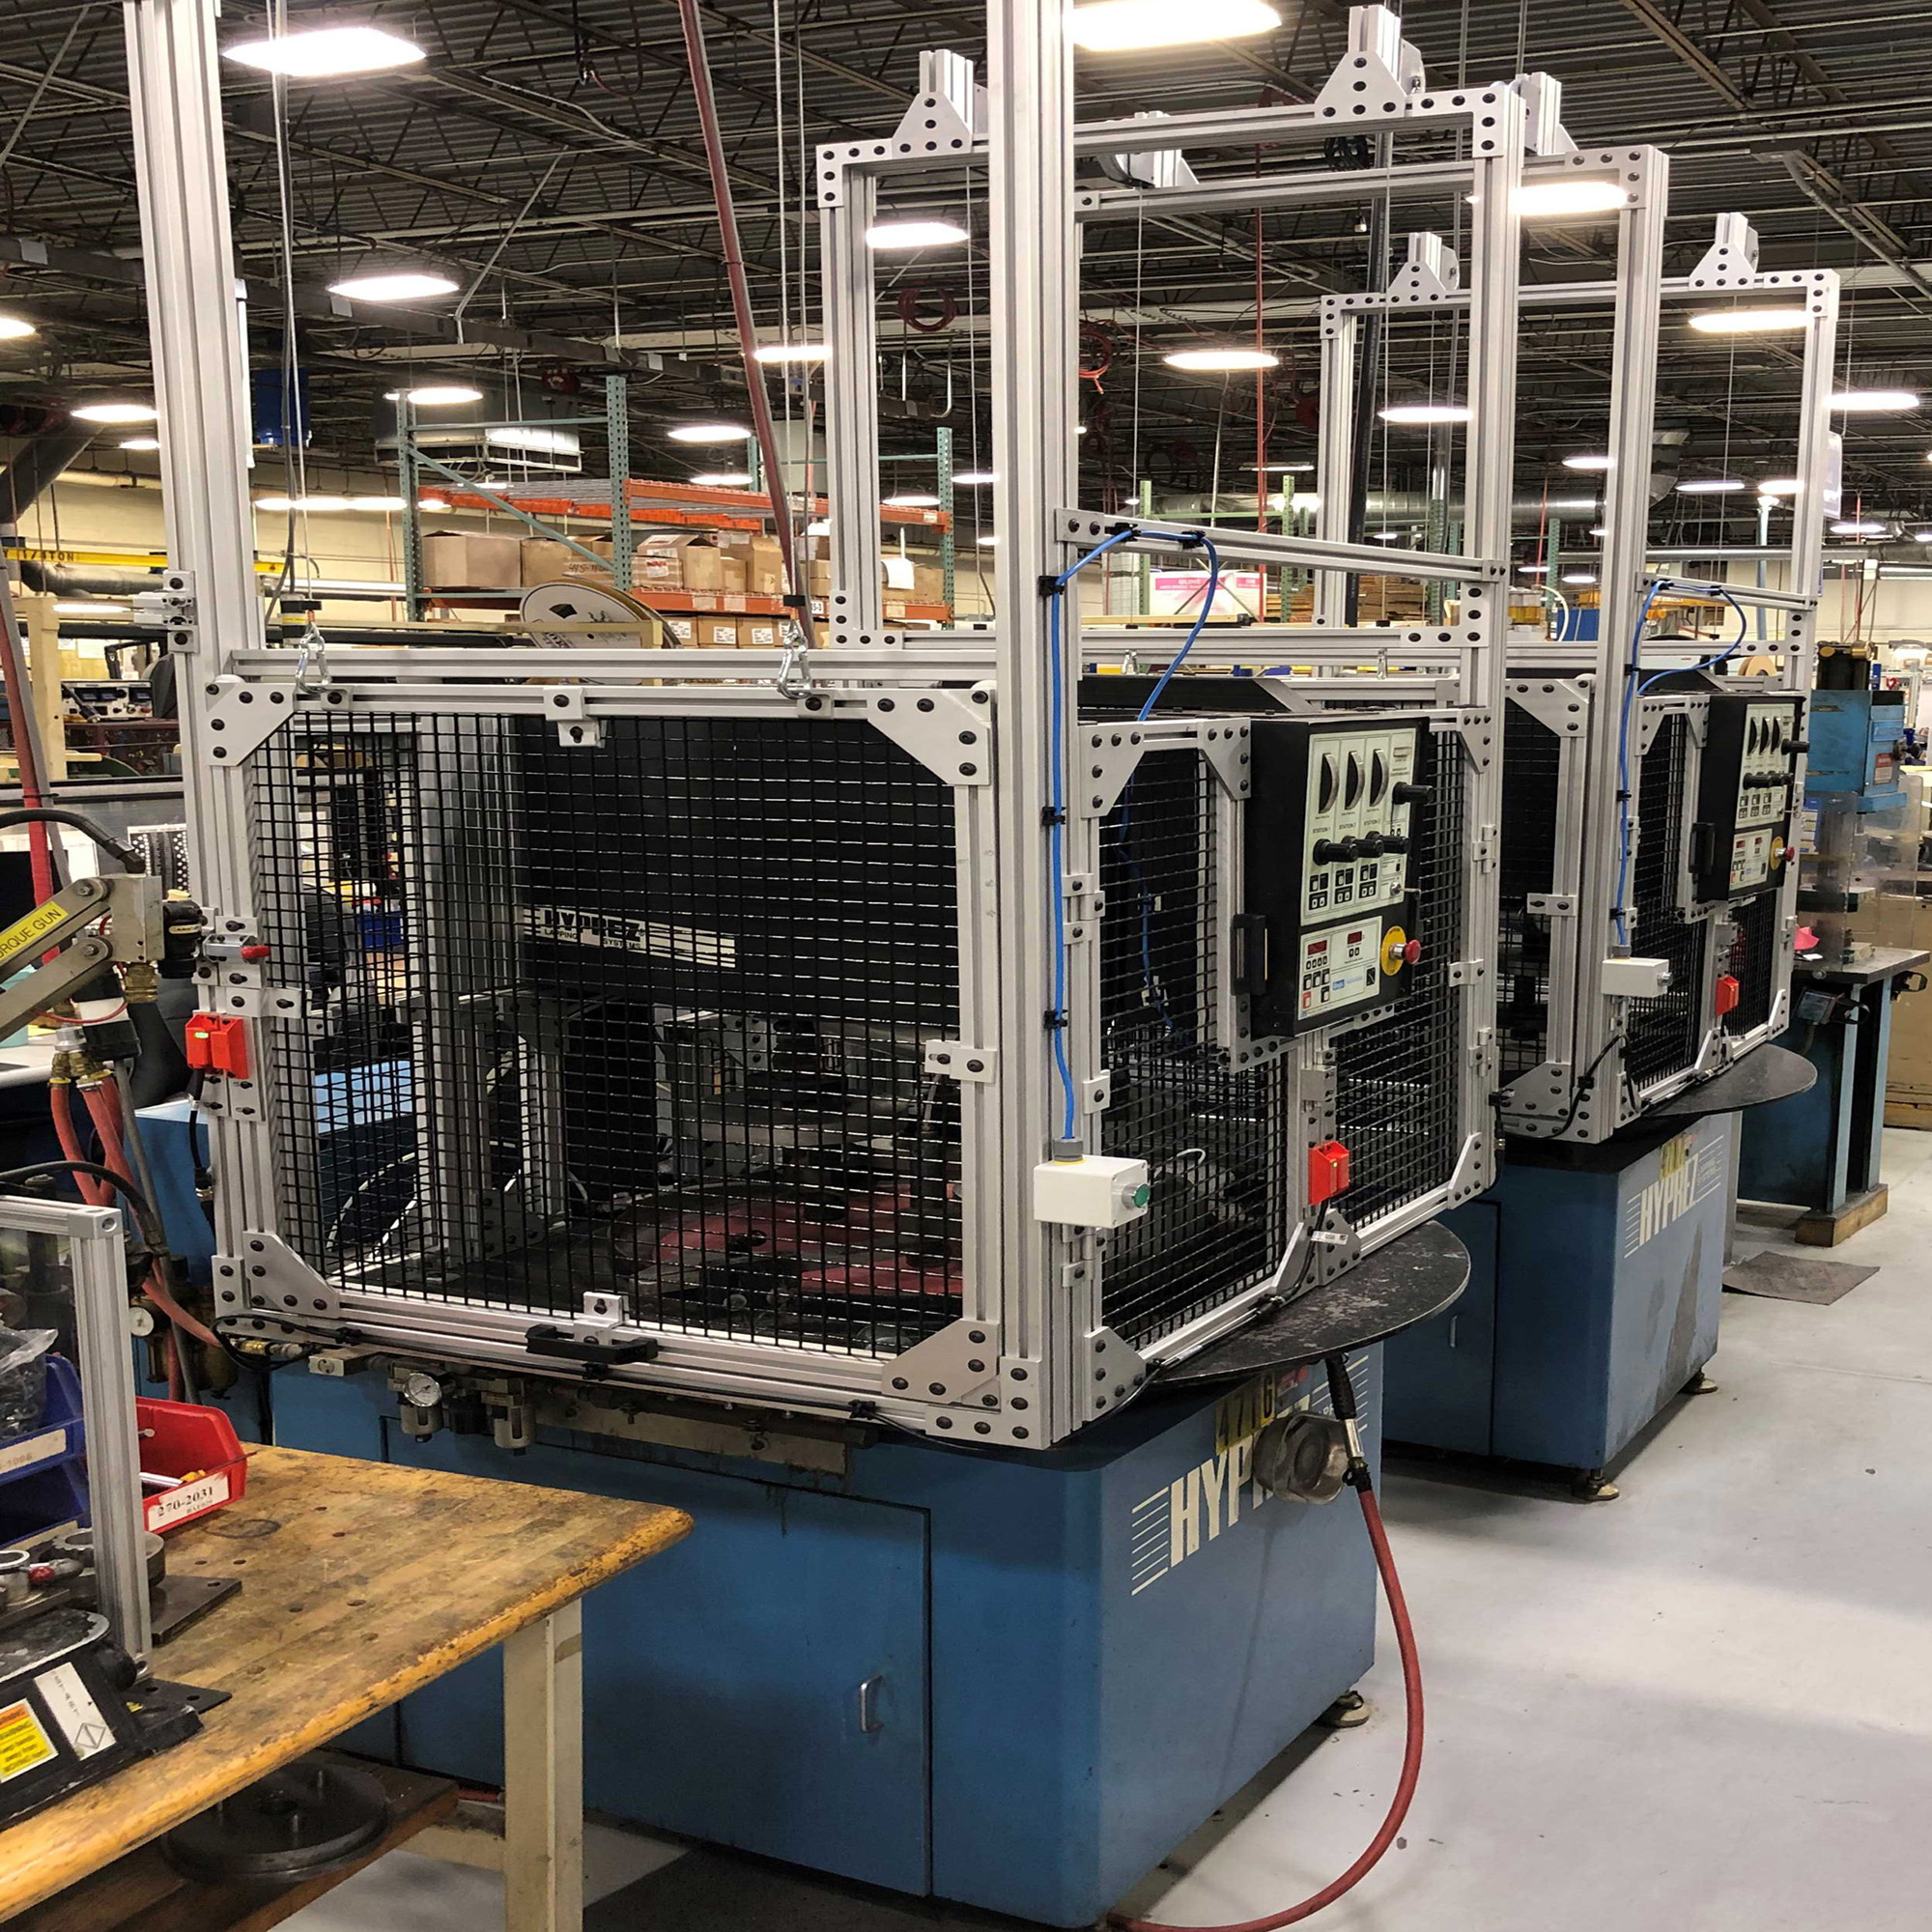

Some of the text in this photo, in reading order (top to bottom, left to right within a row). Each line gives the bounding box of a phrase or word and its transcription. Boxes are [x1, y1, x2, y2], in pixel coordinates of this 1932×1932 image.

[32, 908, 62, 930] GUN
[603, 937, 641, 950] SYSTMS
[156, 1486, 213, 1518] 270-2031
